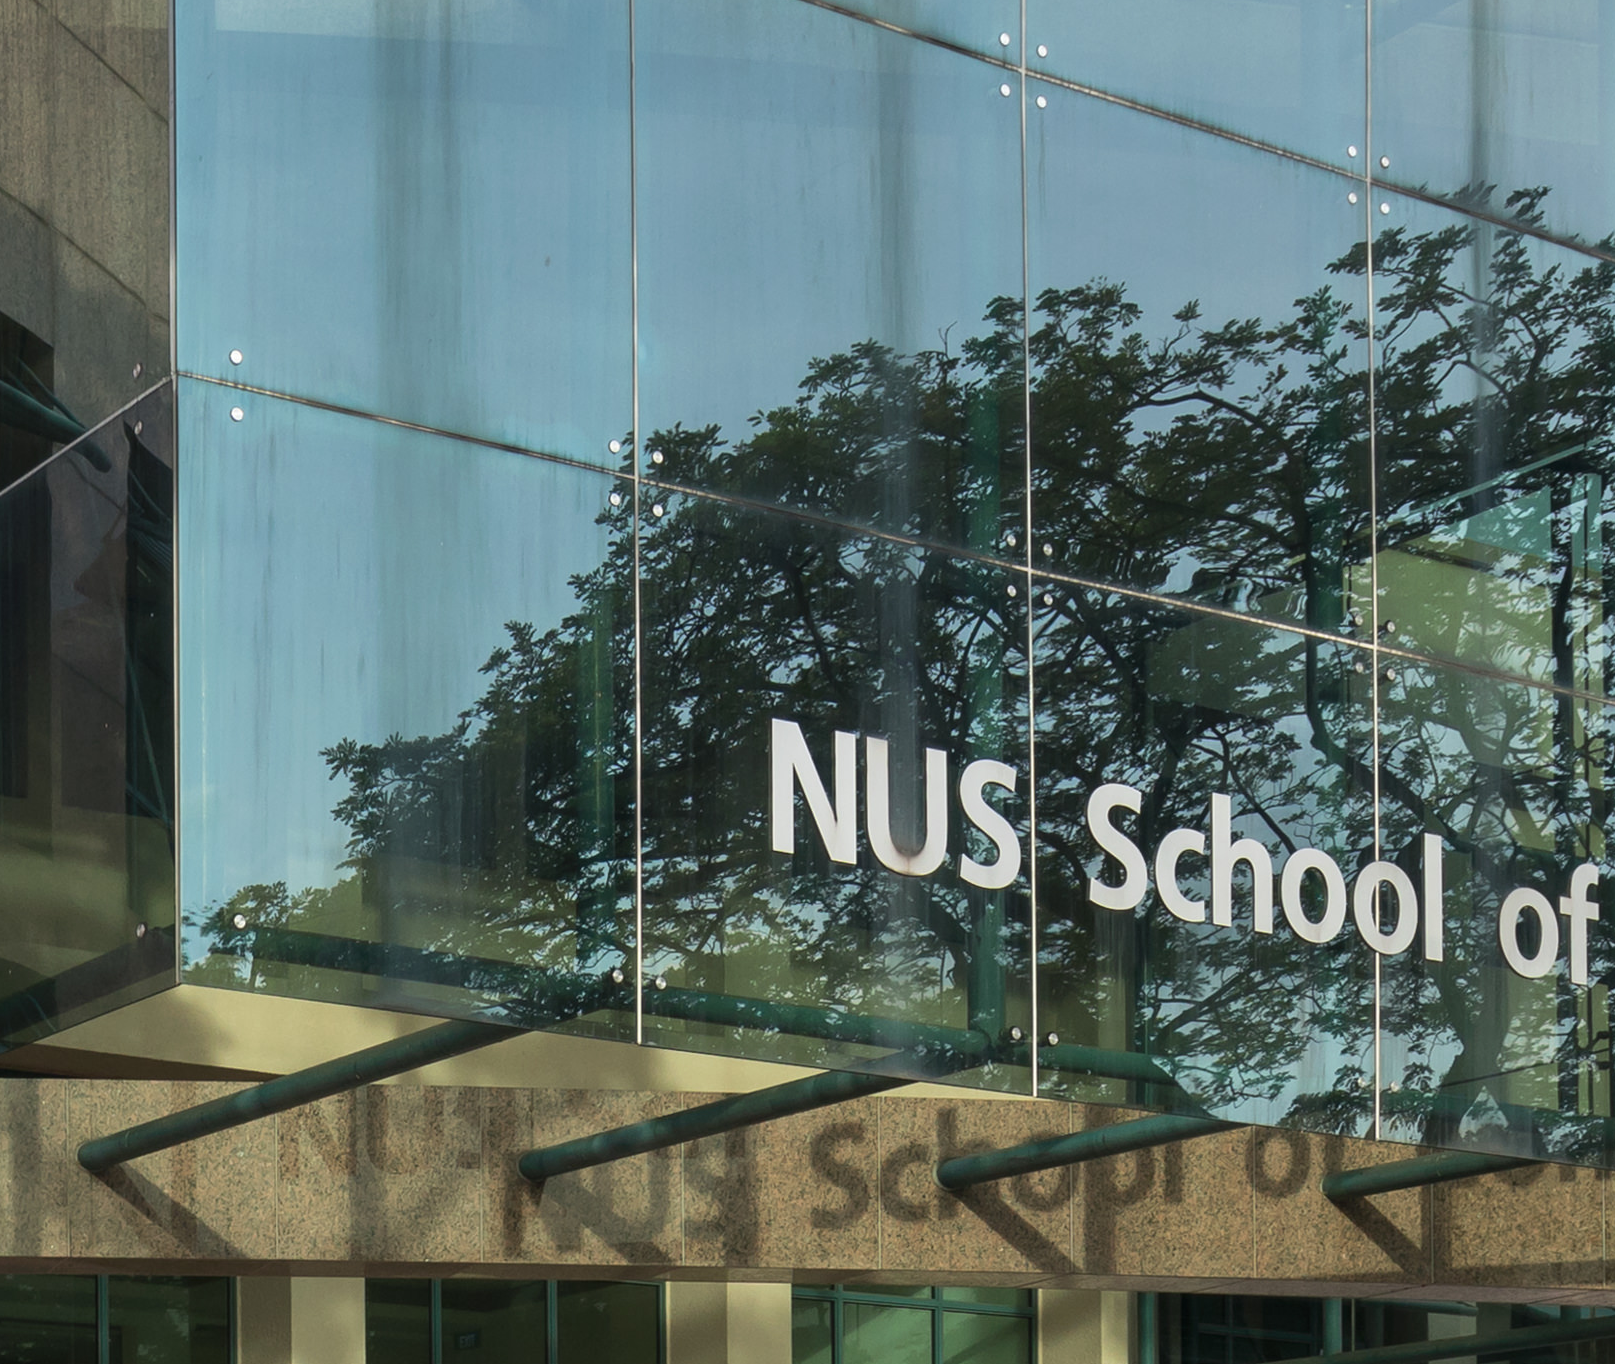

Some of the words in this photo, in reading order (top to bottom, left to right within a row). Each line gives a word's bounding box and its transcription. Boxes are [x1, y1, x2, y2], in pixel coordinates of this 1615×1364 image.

[771, 718, 1022, 890] NUS
[1085, 783, 1444, 962] School
[1498, 863, 1600, 985] of
